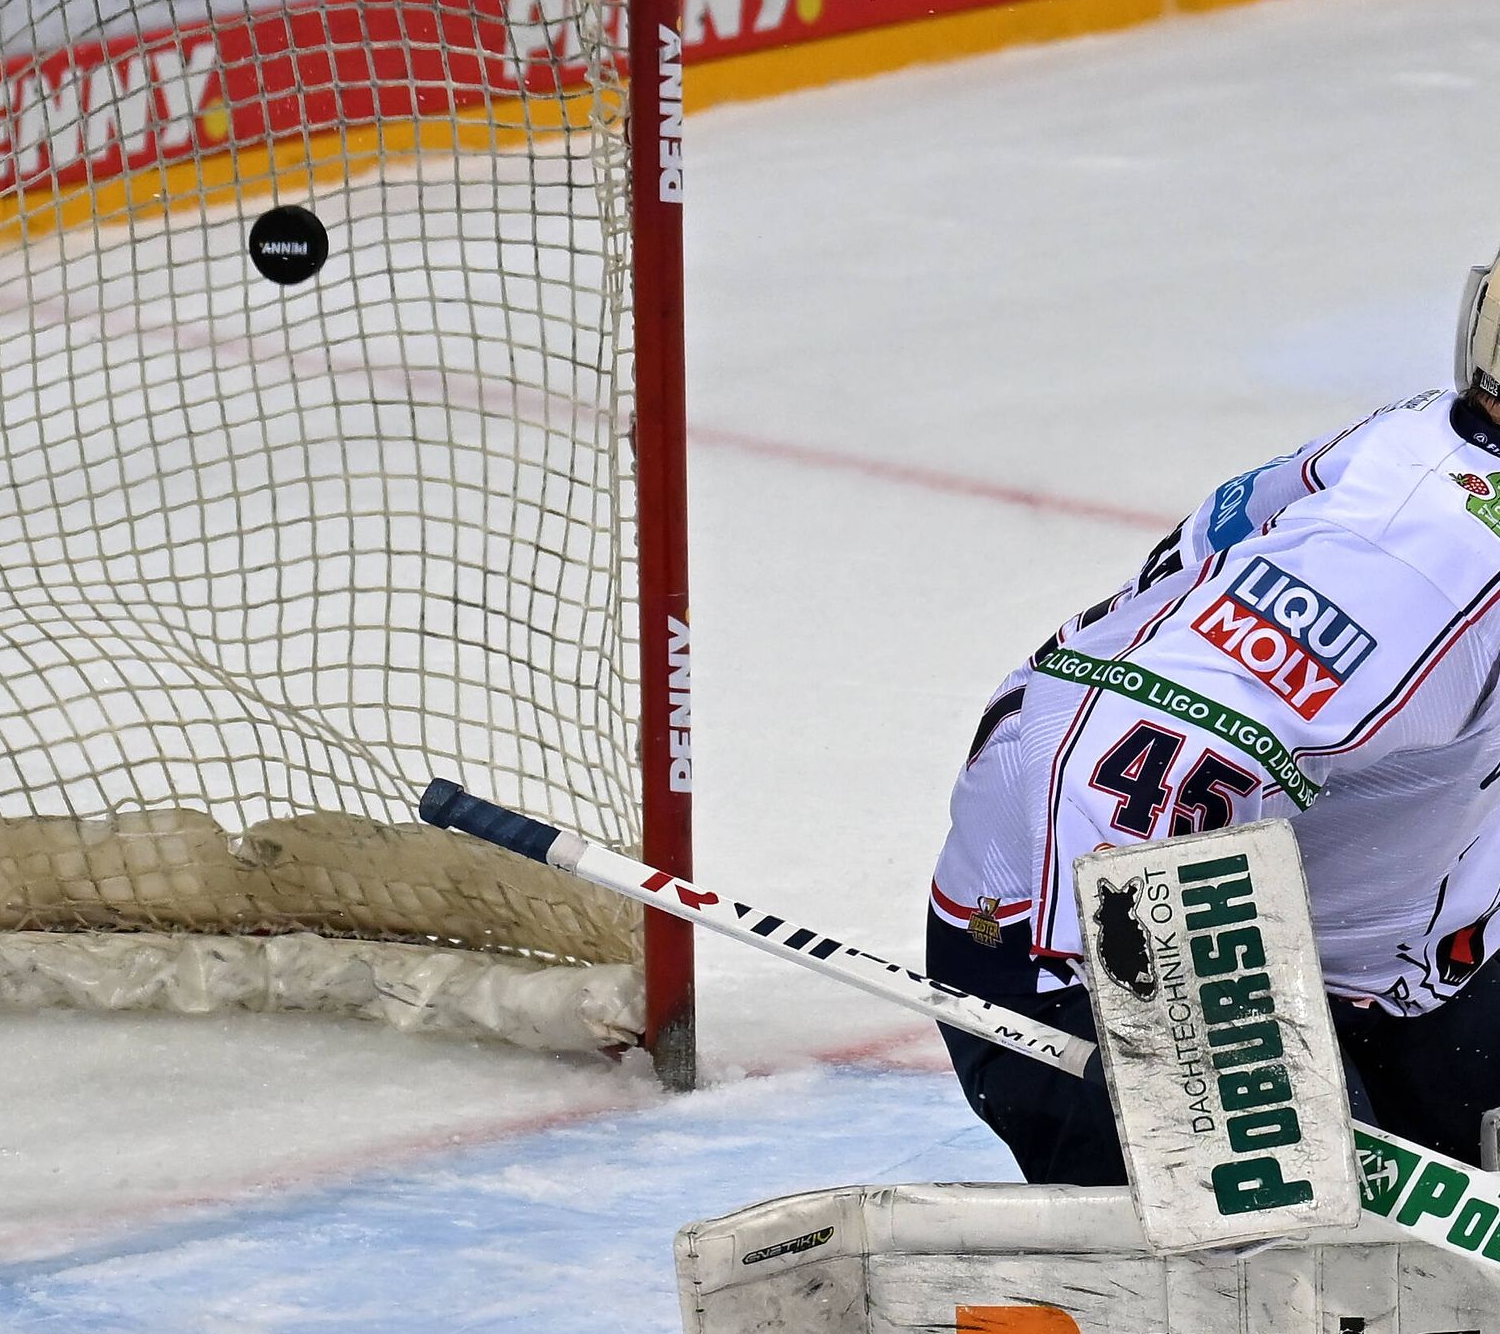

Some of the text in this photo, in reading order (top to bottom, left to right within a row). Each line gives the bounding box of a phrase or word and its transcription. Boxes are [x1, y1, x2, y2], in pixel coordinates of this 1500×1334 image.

[1199, 602, 1340, 710] MOLY
[1235, 562, 1373, 676] LIQUI
[1089, 720, 1262, 839] 45
[1091, 664, 1143, 692] LIGO
[1148, 682, 1209, 720] LIGO
[1214, 713, 1274, 756] LIGO
[1268, 749, 1301, 789] LIGO
[1144, 866, 1216, 1133] DACHTECHNIK OST
